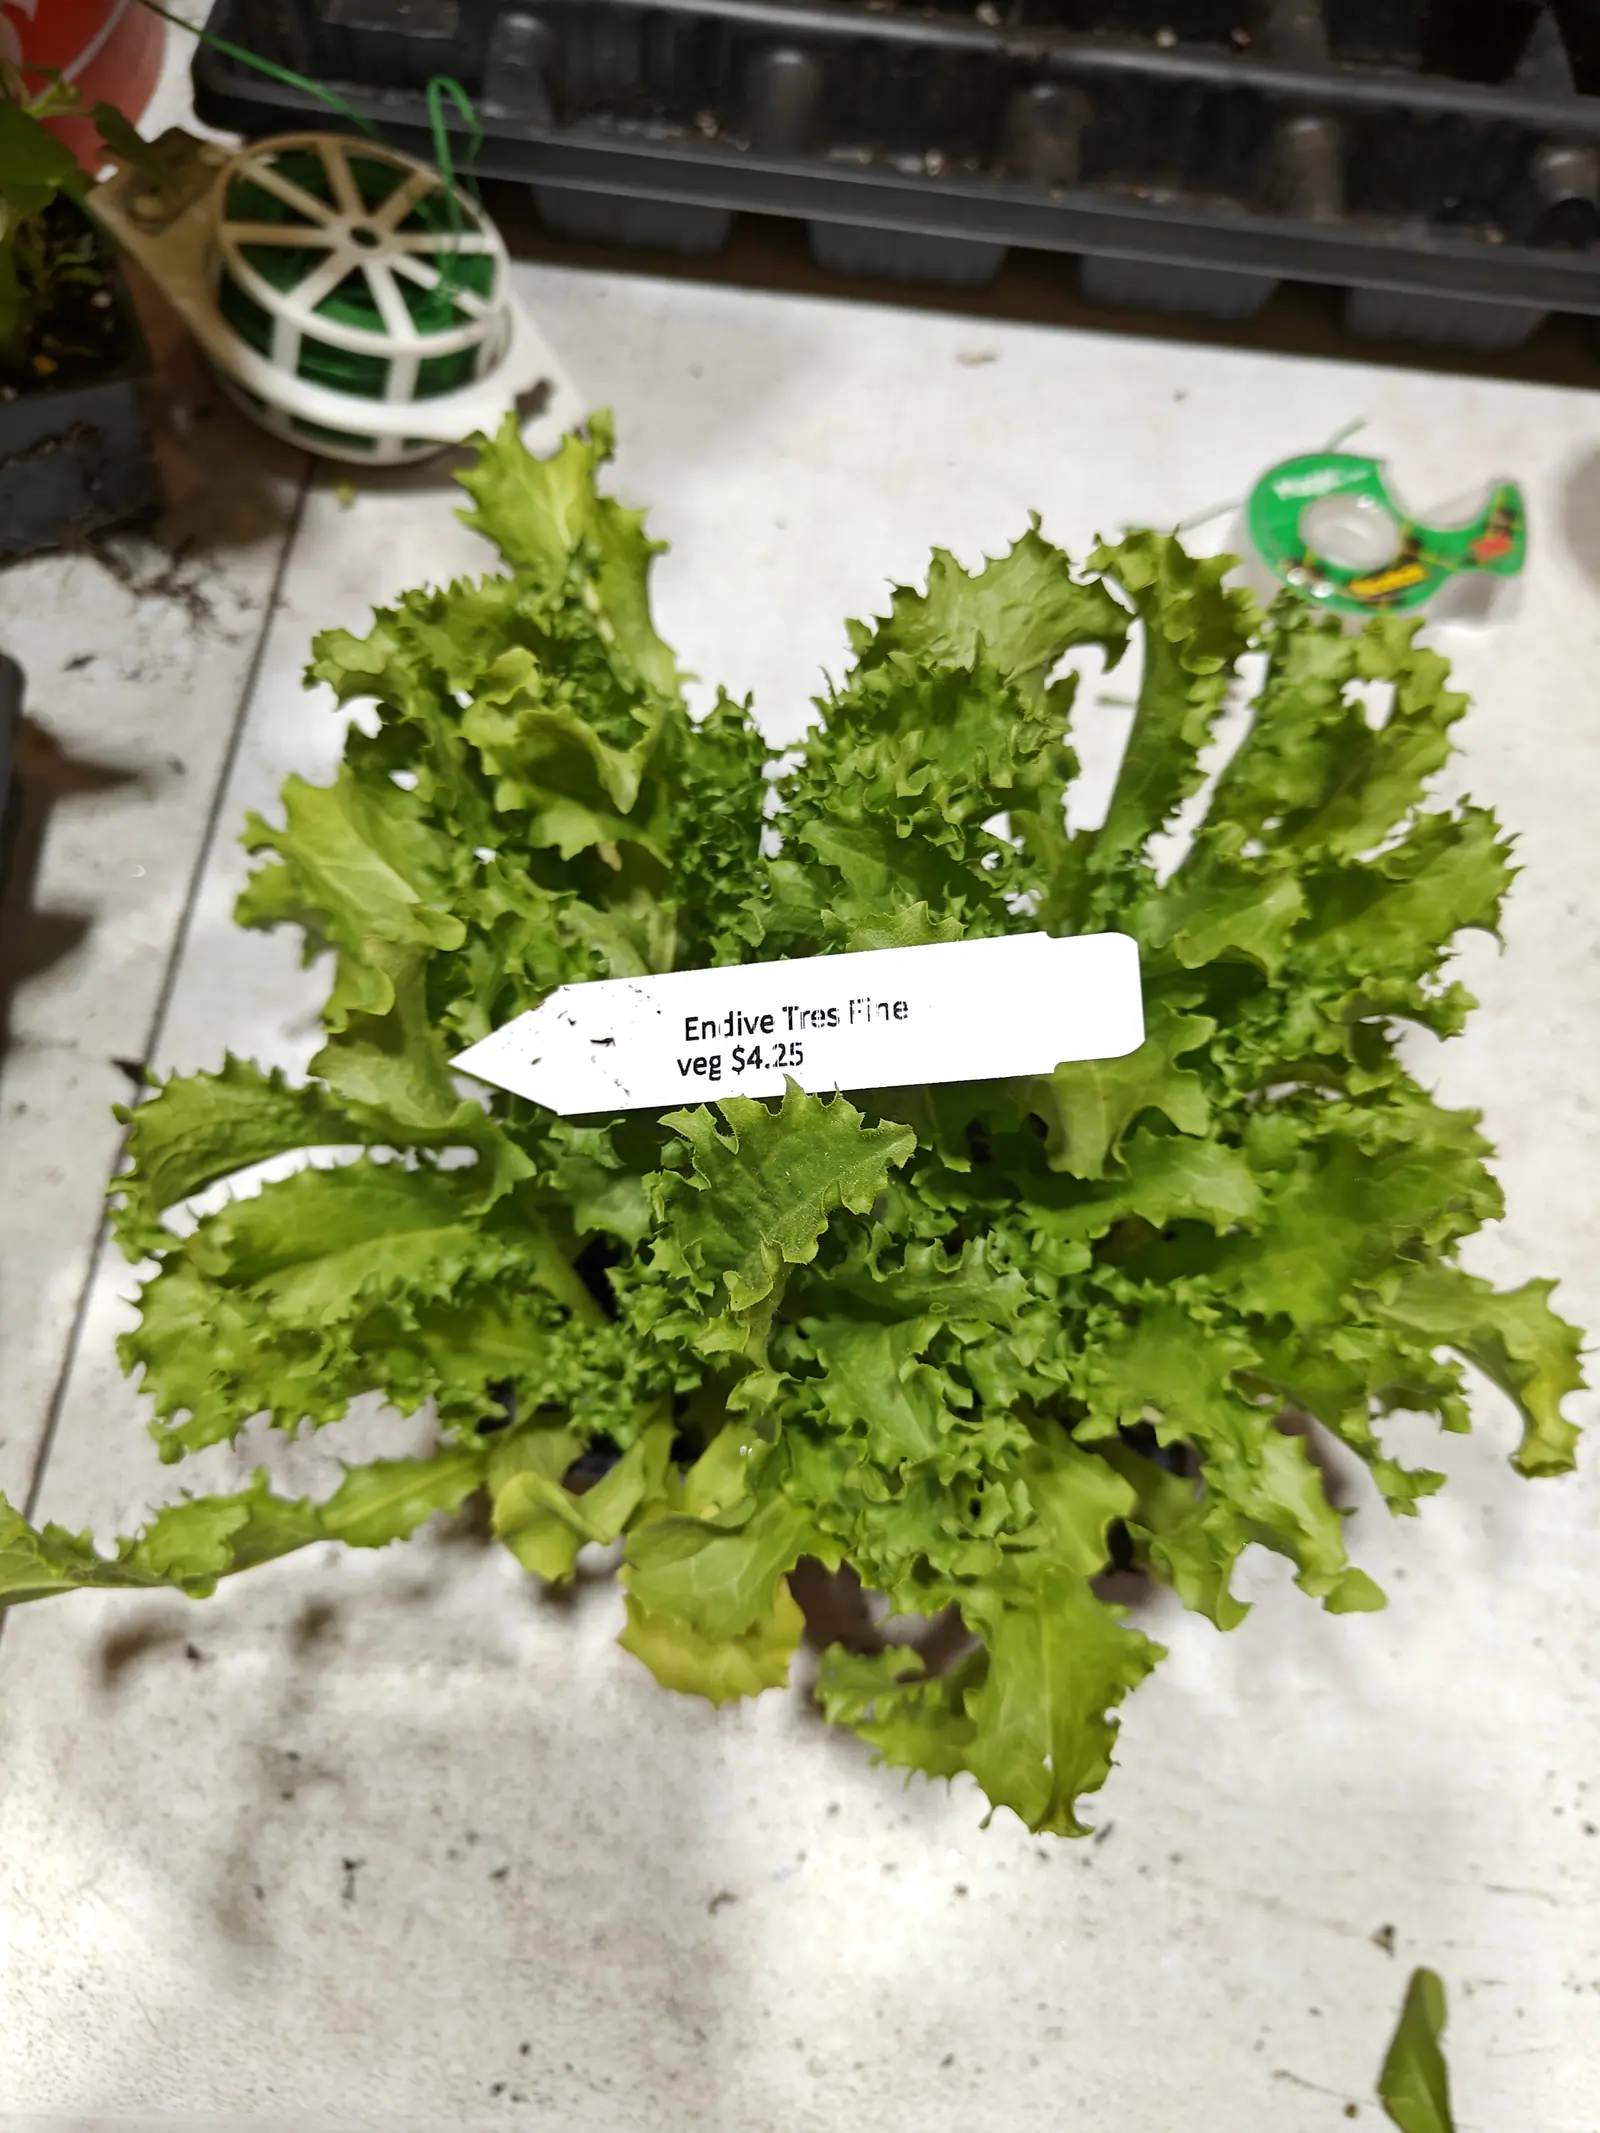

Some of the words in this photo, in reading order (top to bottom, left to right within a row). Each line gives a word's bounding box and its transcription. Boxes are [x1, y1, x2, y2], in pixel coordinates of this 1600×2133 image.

[685, 1010, 775, 1041] Endive
[782, 1006, 840, 1031] Tres
[849, 997, 908, 1024] Fine
[677, 1055, 722, 1081] veg
[731, 1042, 804, 1075] $4.25
